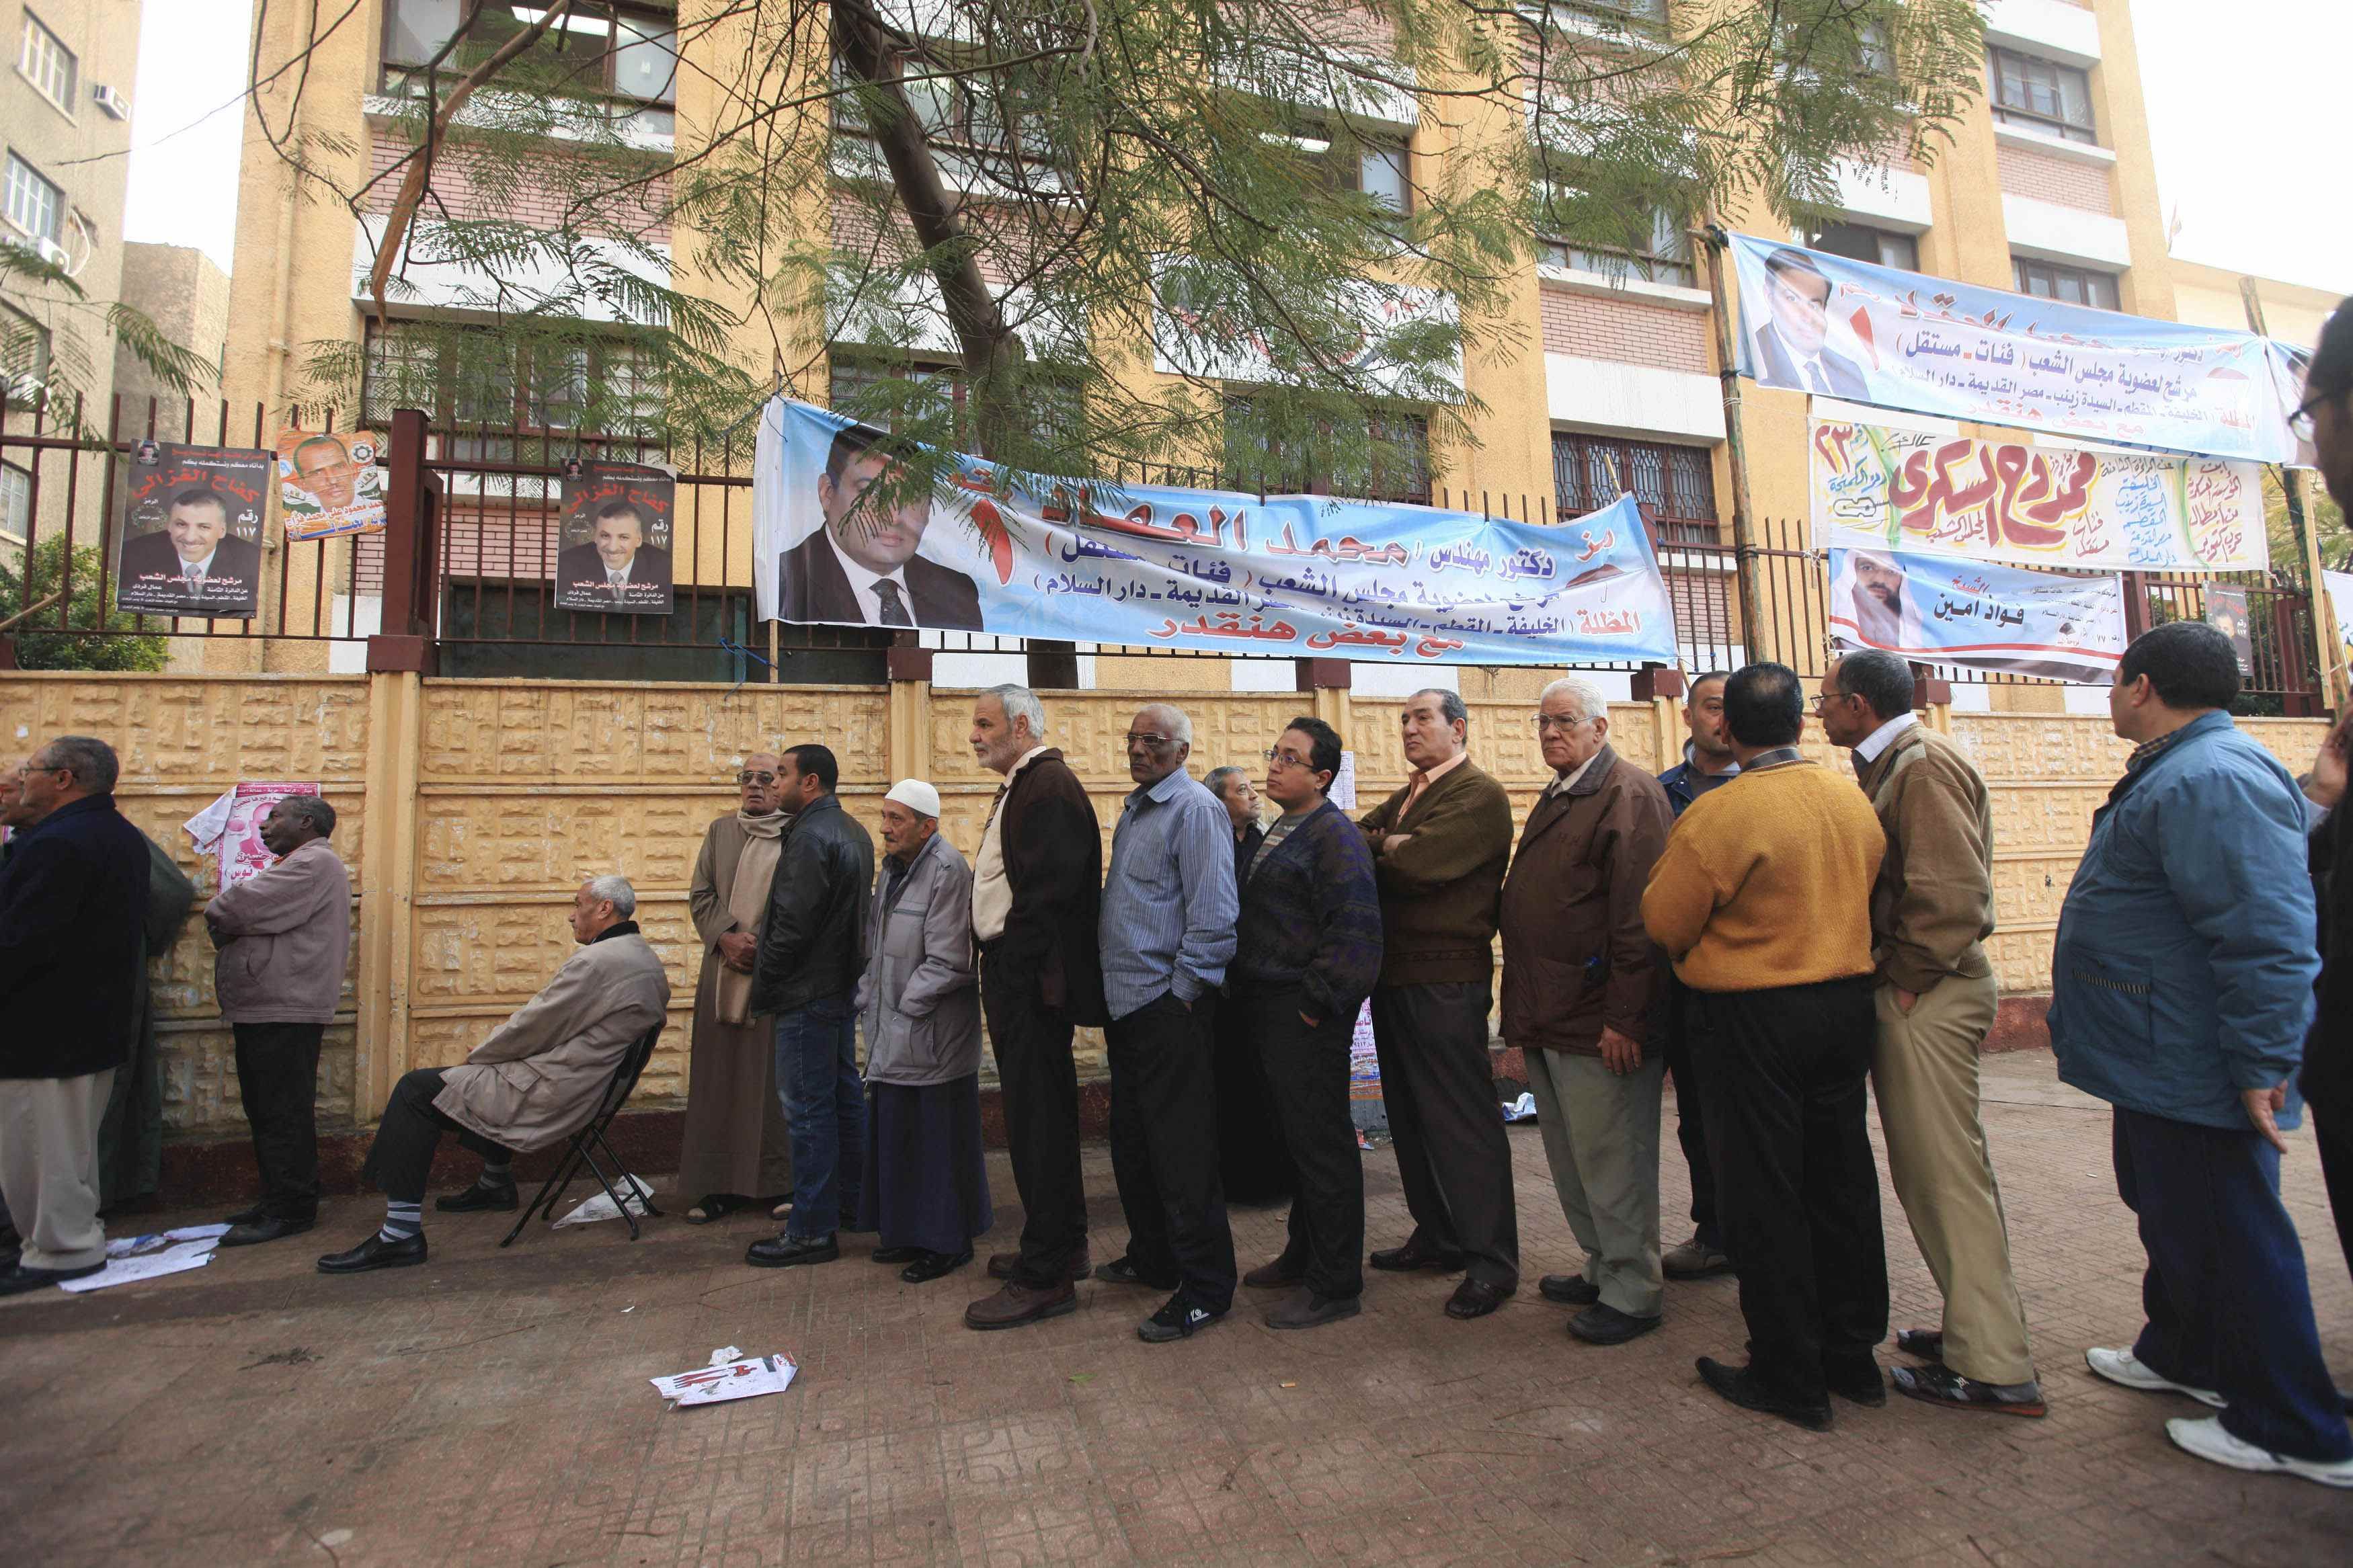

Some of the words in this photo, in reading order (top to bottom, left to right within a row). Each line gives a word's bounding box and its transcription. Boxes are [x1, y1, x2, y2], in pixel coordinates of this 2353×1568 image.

[1905, 331, 1962, 358] مستقل
[2028, 349, 2074, 377] الشعب
[2075, 360, 2114, 388] مجلس
[1938, 371, 1956, 388] دار
[1967, 370, 2017, 395] القديمة
[2118, 362, 2163, 395] لعضوية
[2163, 374, 2198, 403] مرشح
[2019, 386, 2044, 401] مصر
[2053, 389, 2079, 409] زينب
[2081, 392, 2117, 413] السيدة
[2051, 411, 2109, 436] بعض
[2116, 421, 2147, 439] مع
[237, 509, 259, 524] رقم
[651, 519, 669, 533] رقم
[235, 526, 257, 538] ١١٧
[650, 535, 668, 545] ١١٧
[1264, 520, 1410, 567] محمد
[1168, 554, 1232, 584] فئات
[1429, 540, 1493, 577] مهندس
[1496, 546, 1557, 583] دكتور
[138, 572, 166, 582] الشعب
[167, 574, 192, 584] مجلس
[193, 574, 221, 585] لعضوية
[221, 575, 243, 585] مرشح
[572, 580, 594, 589] الشعب
[595, 581, 615, 590] مجلس
[641, 582, 659, 591] مرشح
[1258, 566, 1338, 600] الشعب
[1111, 582, 1147, 604] دار
[1166, 578, 1250, 610] القديمة
[1342, 578, 1408, 610] مجلس
[1147, 611, 1298, 641] هنقدر
[1433, 616, 1492, 636] المقطم
[1576, 608, 1642, 635] المظلة
[1306, 620, 1408, 655] بعض
[1415, 632, 1464, 659] مع
